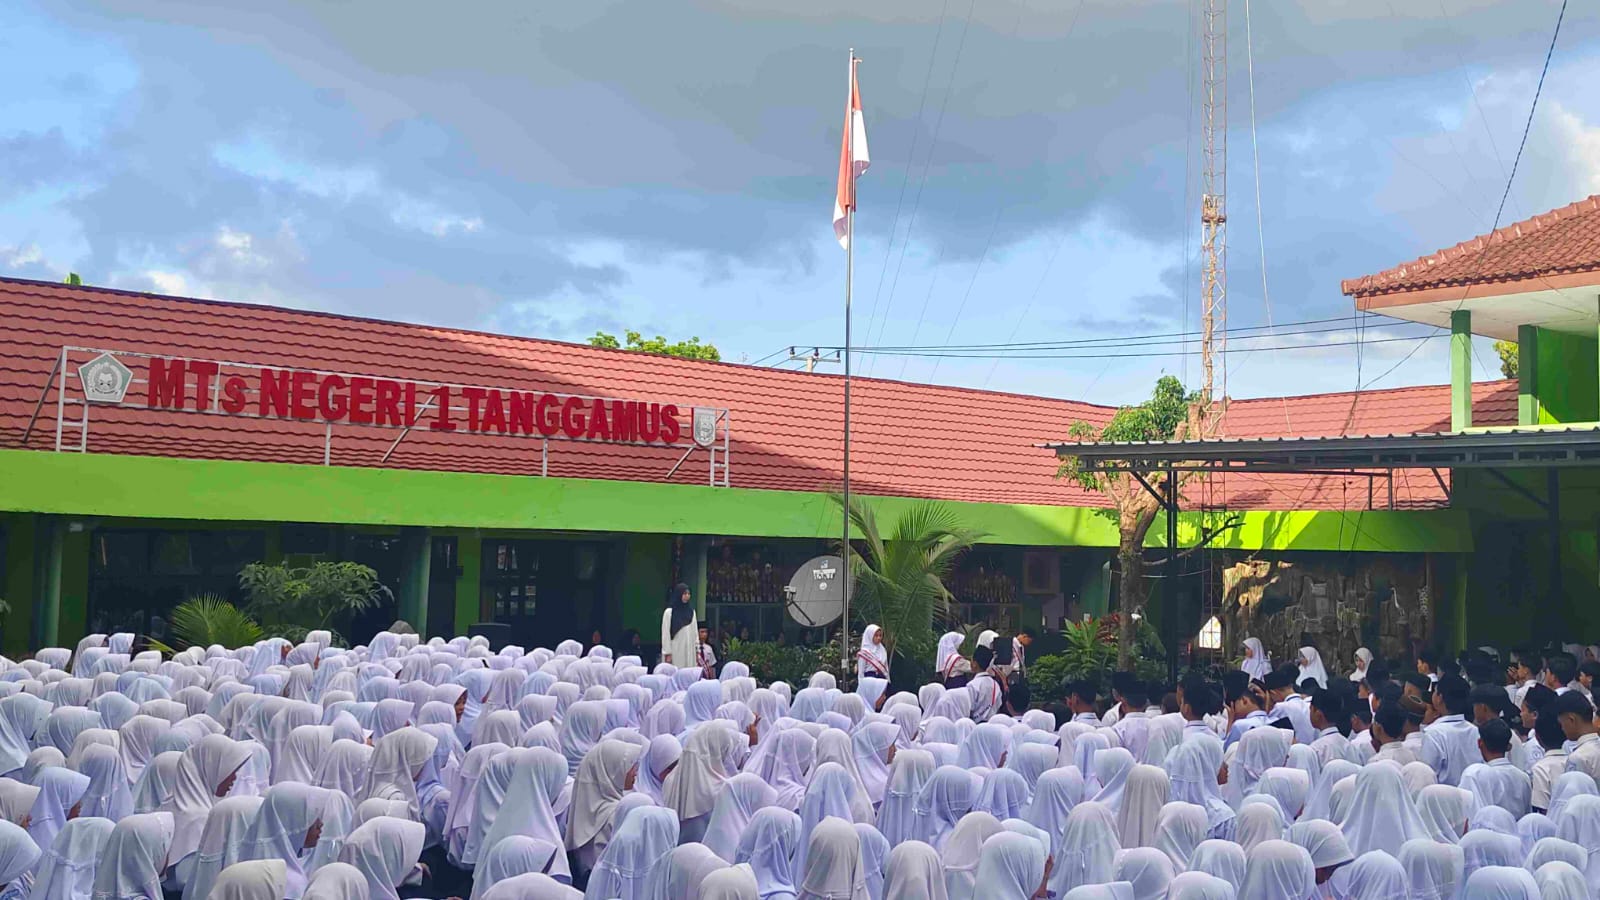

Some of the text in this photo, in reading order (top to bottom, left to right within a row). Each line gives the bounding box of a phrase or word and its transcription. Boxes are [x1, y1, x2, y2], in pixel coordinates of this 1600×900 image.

[148, 358, 680, 443] MTs NEGERI 1 TANGGAMUS
